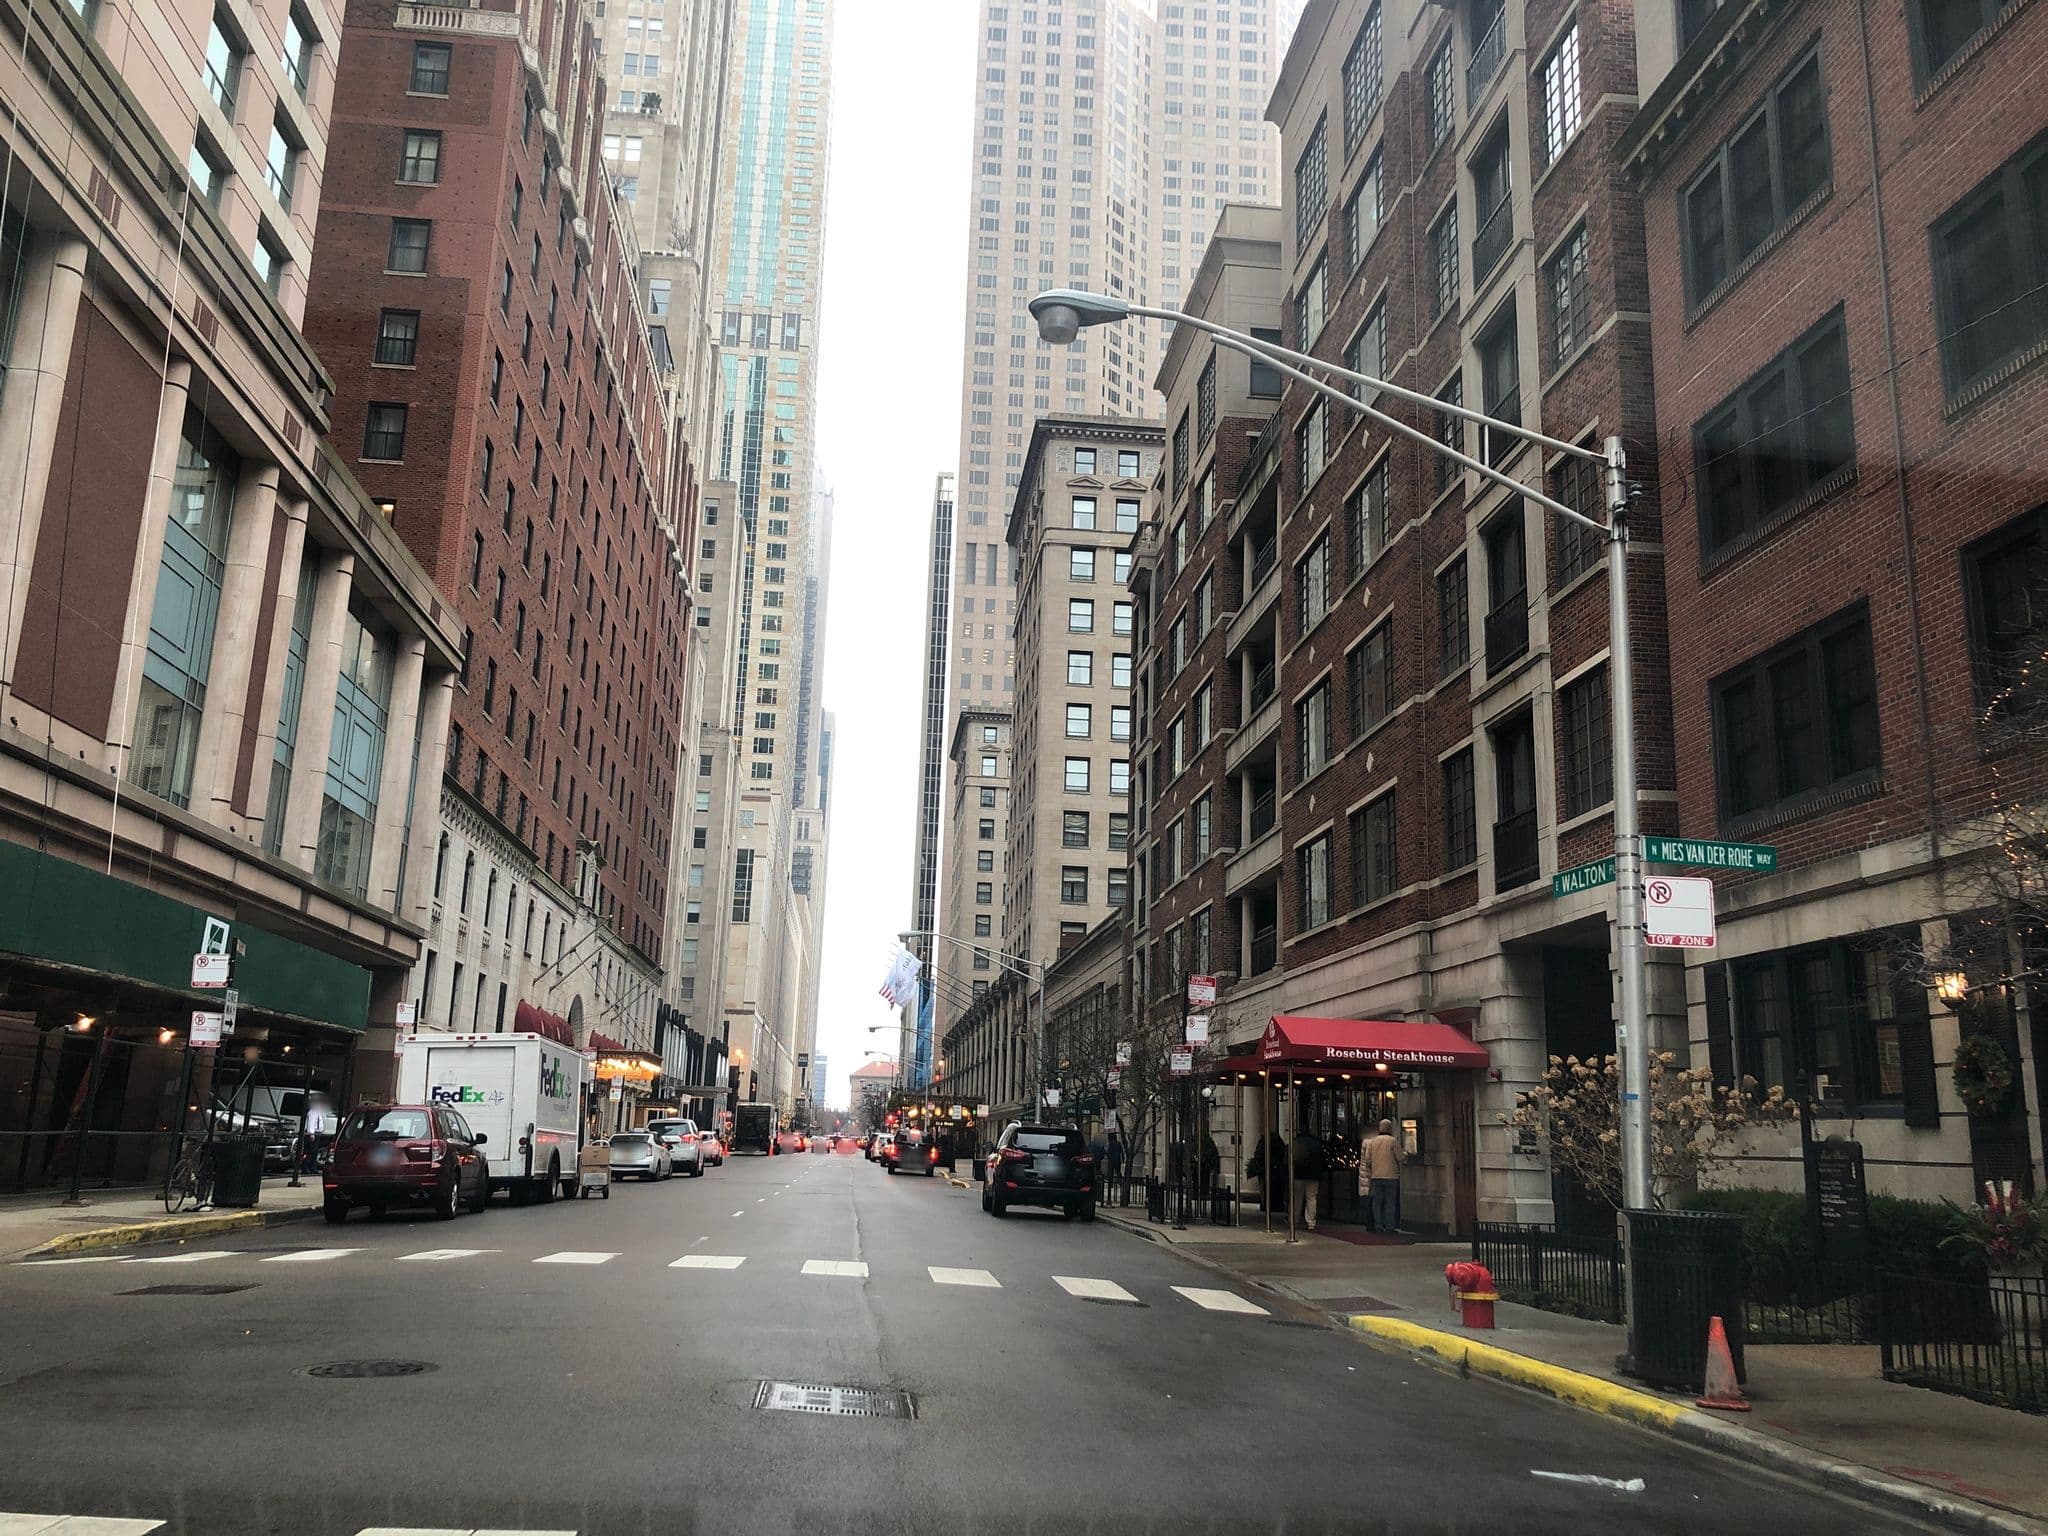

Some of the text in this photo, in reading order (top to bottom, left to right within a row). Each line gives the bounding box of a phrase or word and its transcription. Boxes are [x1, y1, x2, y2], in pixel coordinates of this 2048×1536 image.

[1652, 841, 1772, 867] N MIES VAN DER ROHE WAY
[1561, 863, 1606, 893] WALTON
[1650, 934, 1709, 946] TOW ZONE
[1326, 1047, 1455, 1064] Rosebud Steakhouse
[540, 1053, 565, 1099] FedEx
[431, 1086, 485, 1103] FedEx
